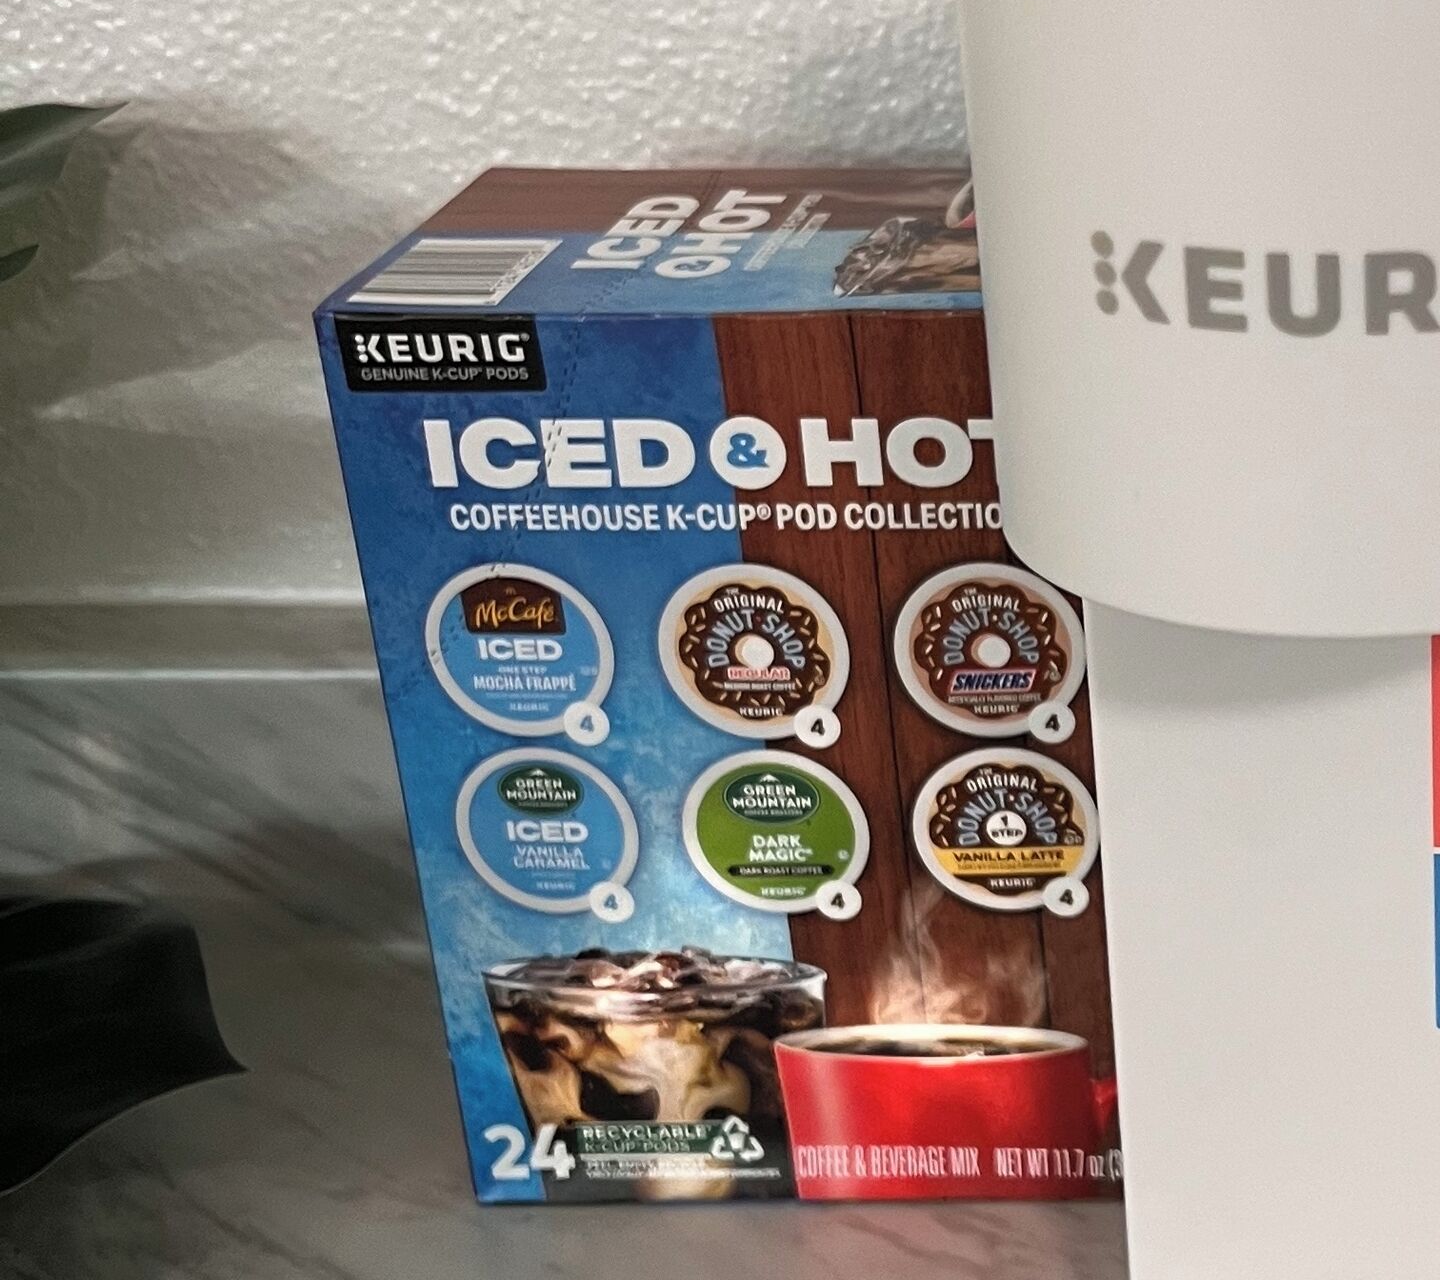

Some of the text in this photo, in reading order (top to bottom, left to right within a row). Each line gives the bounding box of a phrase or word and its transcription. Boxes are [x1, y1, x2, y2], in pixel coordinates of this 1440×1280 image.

[571, 195, 700, 270] ICED
[670, 190, 787, 255] HOT
[354, 333, 526, 363] KEURIG
[361, 367, 430, 382] GENUINE
[487, 367, 529, 381] PODS
[423, 417, 696, 490] ICED
[450, 503, 661, 532] COFFEEHOUSE
[776, 503, 838, 531] POD
[844, 503, 1002, 531] COLLECTIO
[713, 593, 785, 614] ORIGINAL
[951, 593, 1021, 613] ORIGINAL
[706, 608, 807, 670] DONUT SHOP
[942, 607, 1040, 666] DONUT SHOP
[477, 637, 563, 661] ICED
[473, 674, 524, 692] MOCHA
[728, 667, 790, 681] REGULAR
[952, 670, 1034, 692] SNICKERS
[579, 714, 595, 733] 4
[810, 717, 826, 736] 4
[515, 777, 563, 789] GREEN
[743, 784, 797, 797] GREEN
[966, 772, 1039, 793] ORIGINAL
[506, 789, 578, 801] MOUNTAIN
[731, 796, 813, 809] MOUNTAIN
[957, 787, 1058, 847] DONUT SHOP
[505, 820, 590, 844] ICED
[752, 834, 802, 849] DARK
[990, 828, 1024, 838] STEP
[516, 845, 584, 859] VANILLA
[952, 849, 1066, 863] VANILLA LATTE
[483, 1123, 577, 1181] 24
[797, 1144, 850, 1178] COFFEE
[853, 1144, 867, 1178] &
[870, 1145, 947, 1178] BEVERAGE
[949, 1146, 982, 1178] MIX
[994, 1147, 1023, 1178] NET
[1025, 1147, 1050, 1178] WT
[1052, 1148, 1085, 1178] 11.7
[1086, 1154, 1106, 1178] oz
